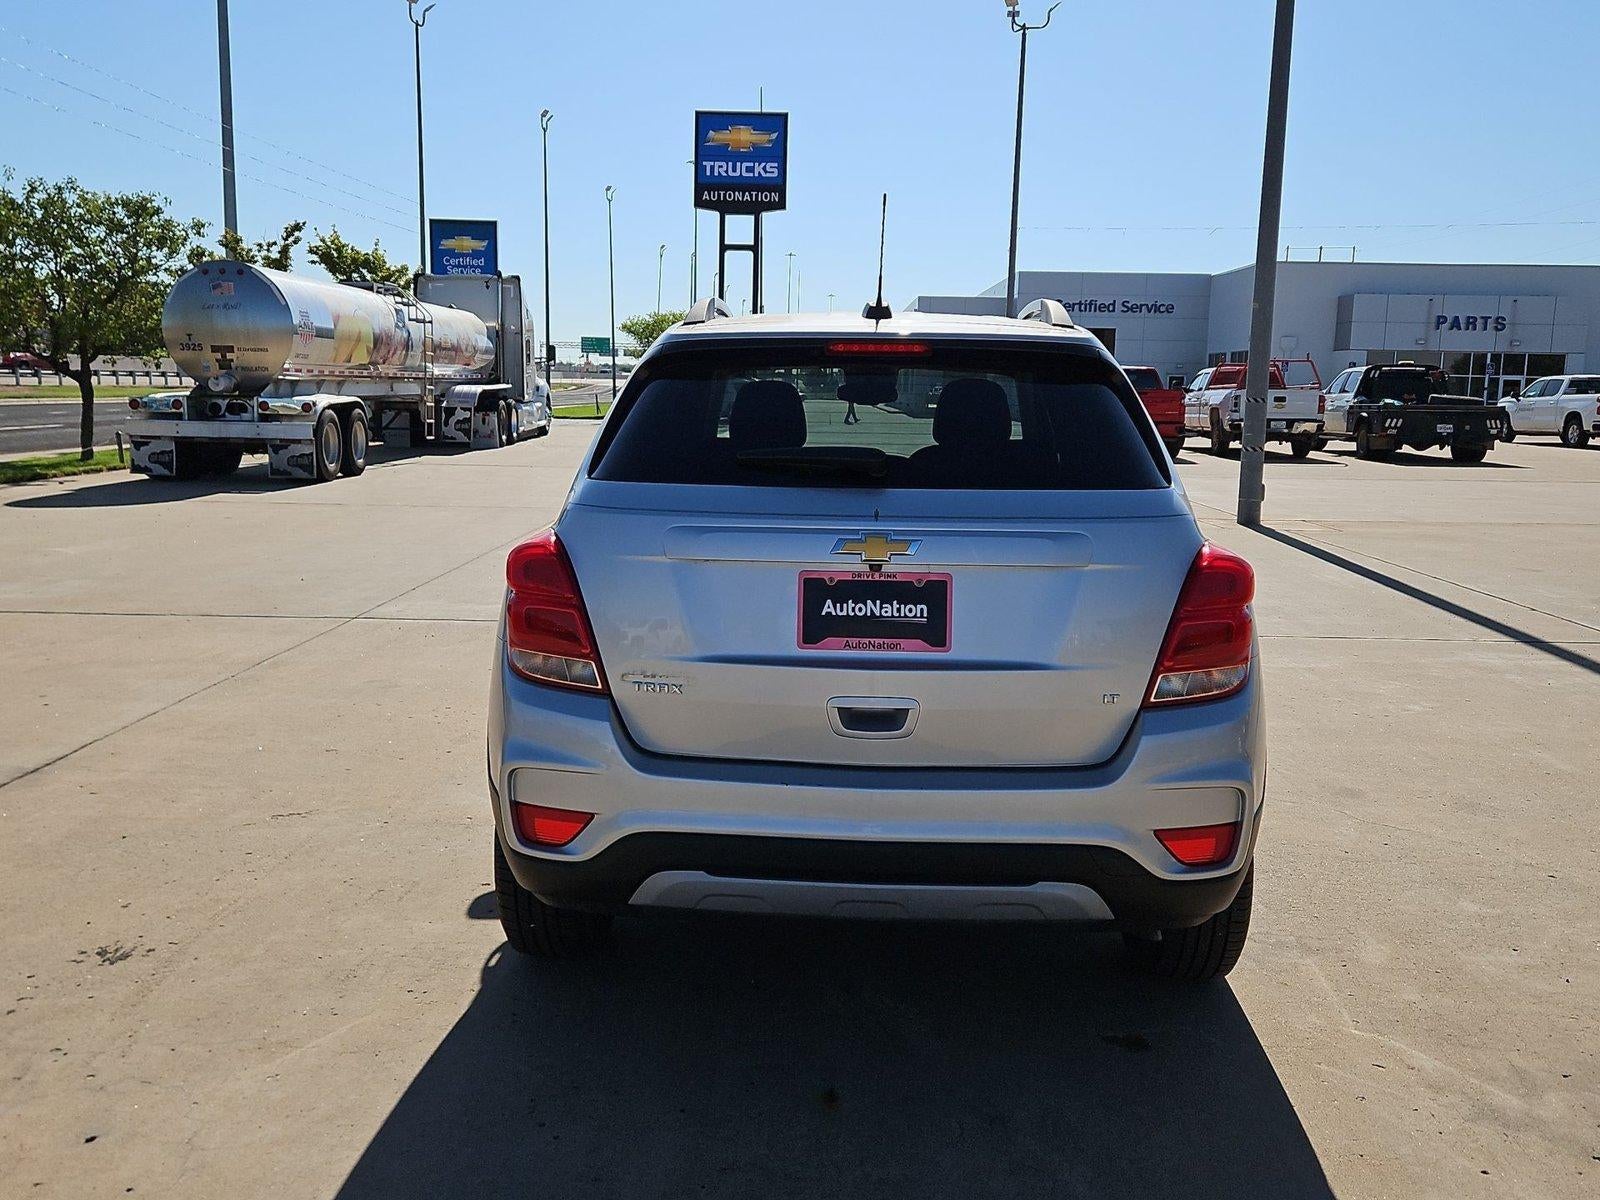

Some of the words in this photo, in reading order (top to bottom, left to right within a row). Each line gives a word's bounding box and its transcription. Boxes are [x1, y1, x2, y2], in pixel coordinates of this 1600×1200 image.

[702, 161, 779, 177] TRUCKS
[702, 190, 779, 202] AUTONATION
[443, 256, 485, 266] Certified
[446, 266, 481, 274] Service
[1120, 300, 1175, 314] Service
[1435, 315, 1507, 332] PARTS
[179, 342, 204, 352] 3925
[851, 572, 876, 580] DRIVE
[821, 599, 928, 617] AutoNation
[632, 681, 683, 694] TRAX
[1102, 693, 1121, 704] LT
